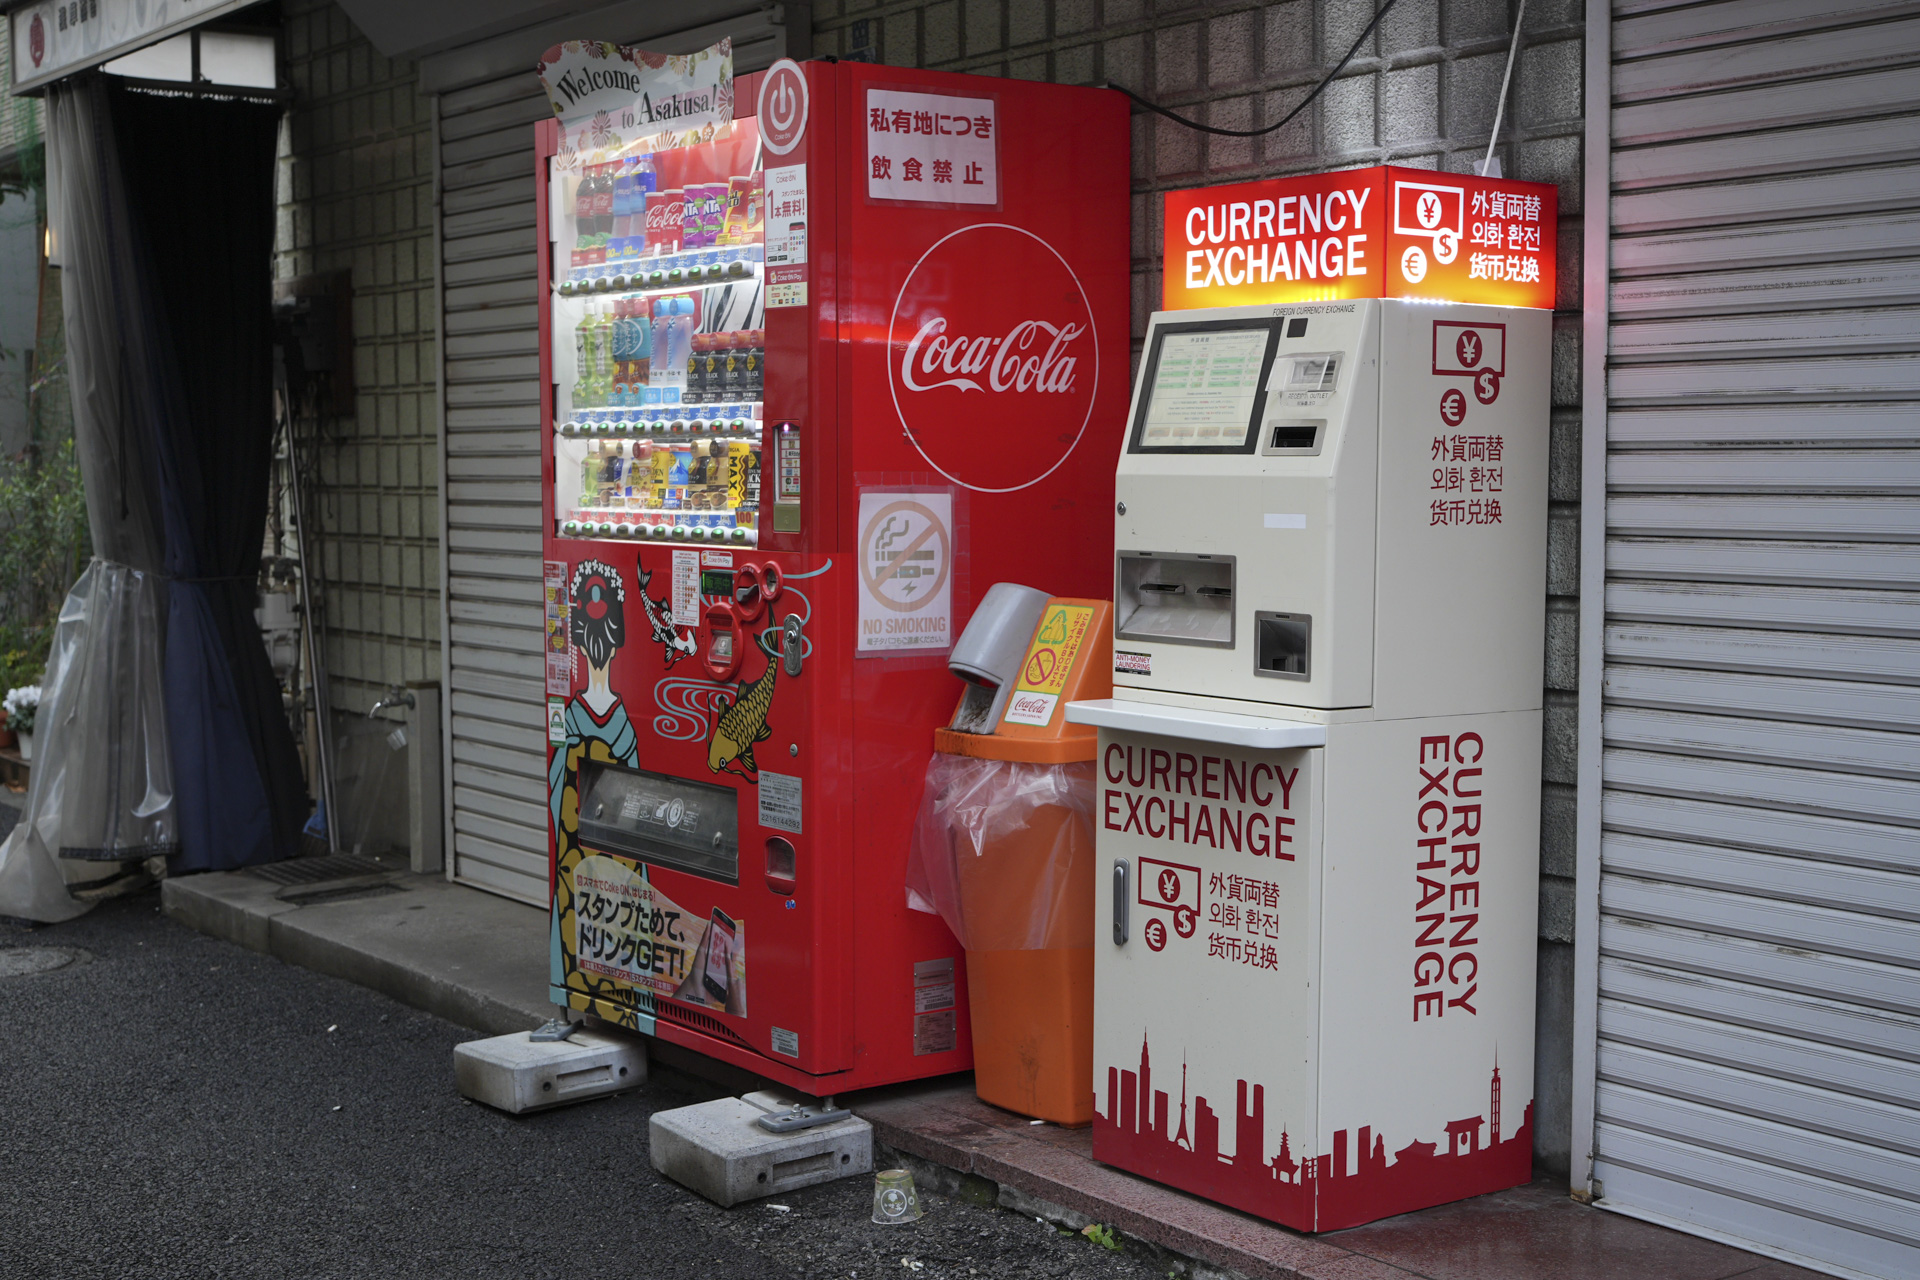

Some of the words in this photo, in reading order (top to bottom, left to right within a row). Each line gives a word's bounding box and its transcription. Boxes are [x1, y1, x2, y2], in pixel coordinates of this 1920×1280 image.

[556, 67, 640, 106] Welcome
[622, 111, 634, 129] to
[637, 84, 717, 125] Asakusa!
[870, 107, 992, 139] 私有地につき
[1185, 187, 1371, 246] CURRENCY
[1471, 190, 1542, 222] 外貨両替
[1470, 221, 1504, 248] 외화
[1507, 224, 1540, 251] 환전
[1185, 234, 1367, 289] EXCHANGE
[1468, 252, 1540, 283] 货币兑换
[1272, 308, 1296, 316] FOREIGN
[1296, 305, 1325, 315] CURRENCY
[1325, 304, 1356, 314] EXCHANGE
[901, 317, 1087, 394] Coca-Cola
[1431, 434, 1504, 462] 外貨両替
[729, 456, 738, 490] MAX
[1430, 466, 1465, 493] 외화
[1469, 466, 1503, 493] 환전
[736, 511, 752, 524] 100
[1429, 498, 1502, 526] 货币兑换
[863, 619, 882, 635] NO
[885, 616, 946, 634] SMOKING
[1115, 654, 1150, 663] ANTI-MONEY
[1115, 660, 1150, 671] LAUNDERING
[1104, 743, 1299, 810] CURRENCY
[1104, 789, 1295, 862] EXCHANGE
[1208, 872, 1280, 909] 外貨両替
[1413, 735, 1450, 1023] EXCHANGE
[1448, 731, 1484, 1017] CURRENCY
[577, 891, 686, 943] スタンプためて、
[1208, 902, 1241, 931] 외화
[1245, 908, 1279, 940] 환전
[579, 922, 684, 980] ドリンクGET!
[1207, 931, 1279, 972] 货币兑换
